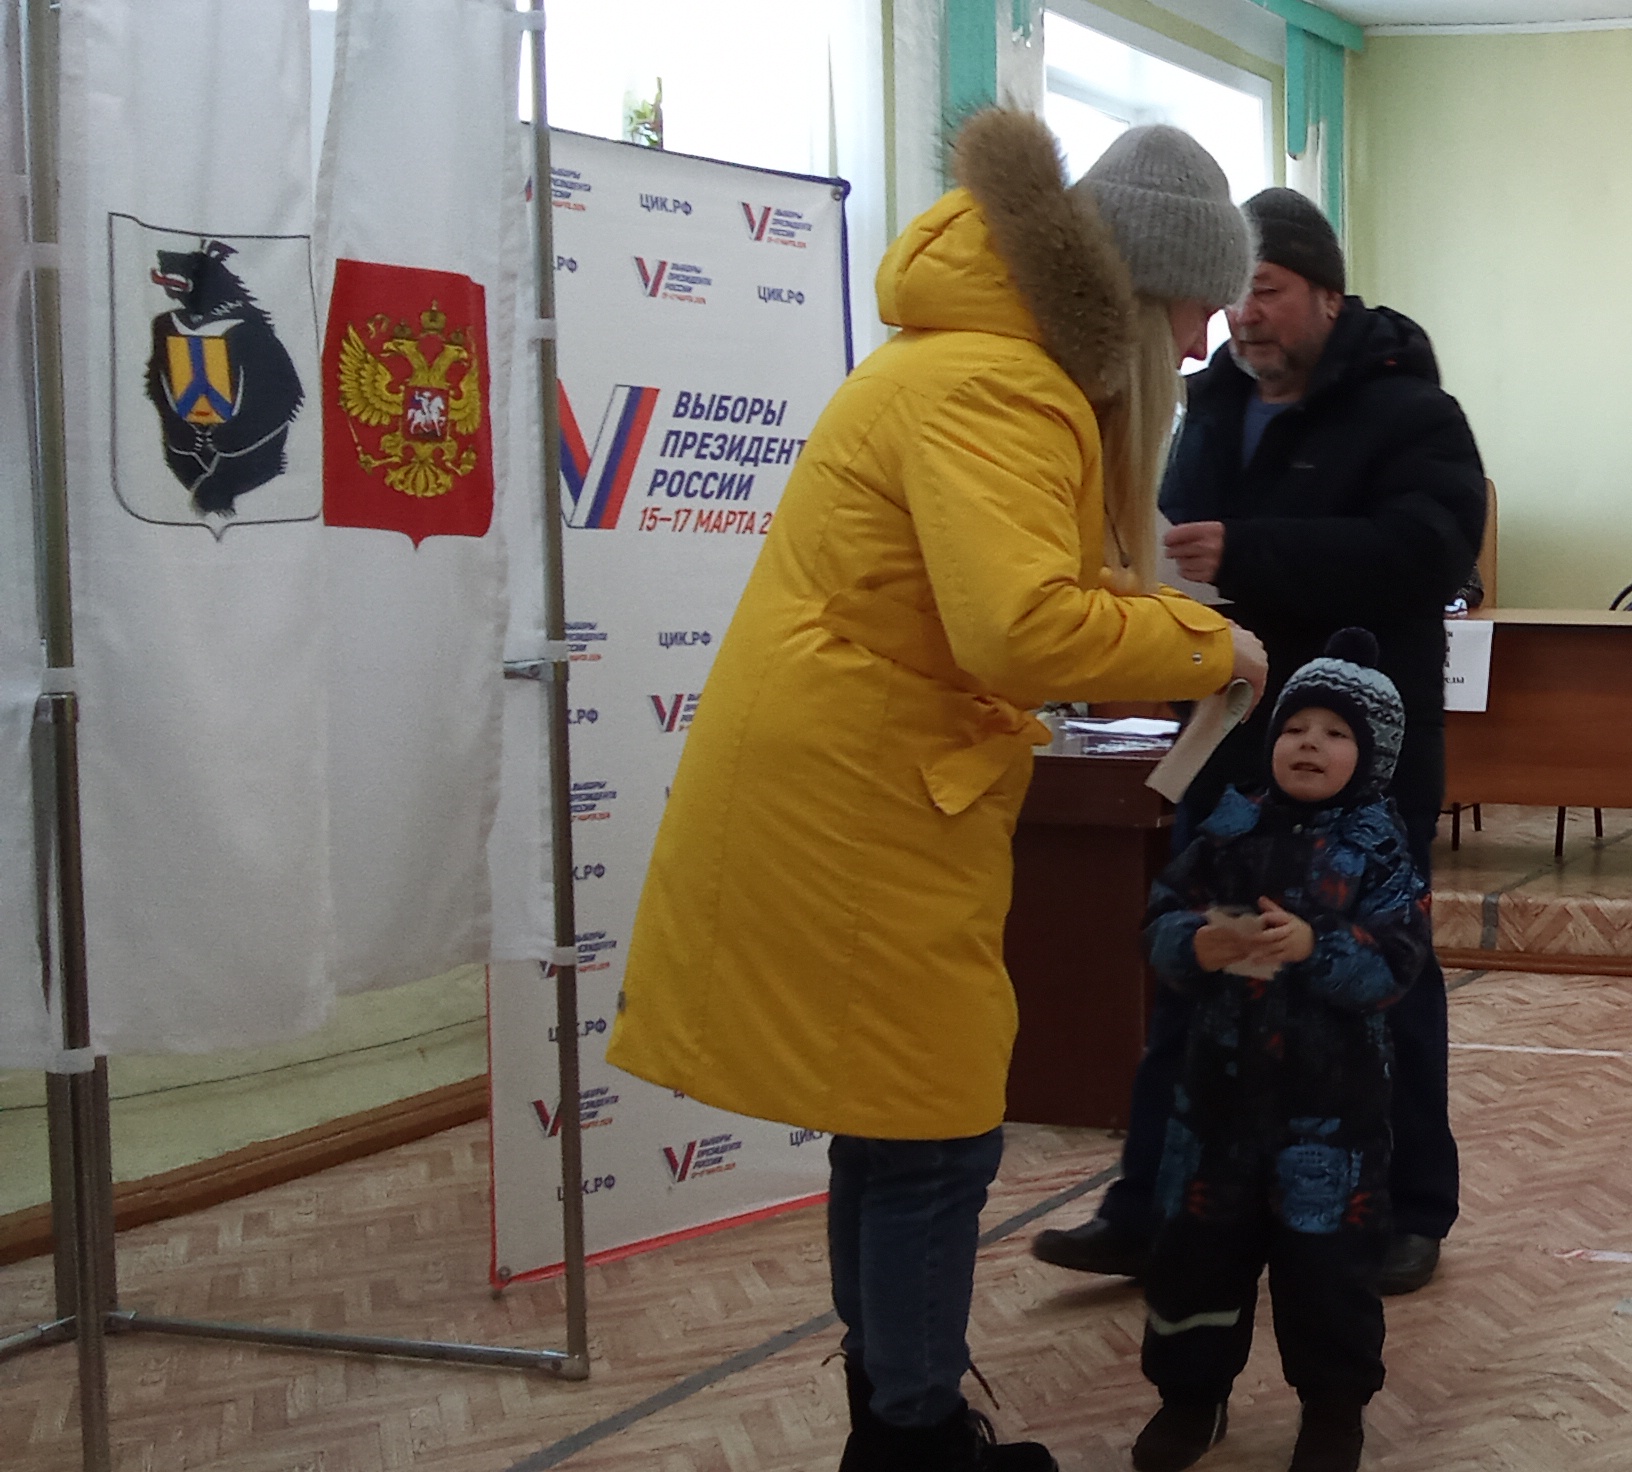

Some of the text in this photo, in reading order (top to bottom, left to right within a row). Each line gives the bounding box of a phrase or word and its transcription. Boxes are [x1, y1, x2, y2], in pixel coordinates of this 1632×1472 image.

[639, 193, 692, 216] ЦИК.РФ
[757, 285, 805, 306] ЦИК.РФ
[672, 391, 788, 426] ВЫБОРЫ
[659, 429, 808, 467] ПРЕЗИДЕНТ
[647, 468, 756, 501] РОССИИ
[693, 509, 756, 534] МАРТА
[658, 631, 712, 650] ЦИК.РФ
